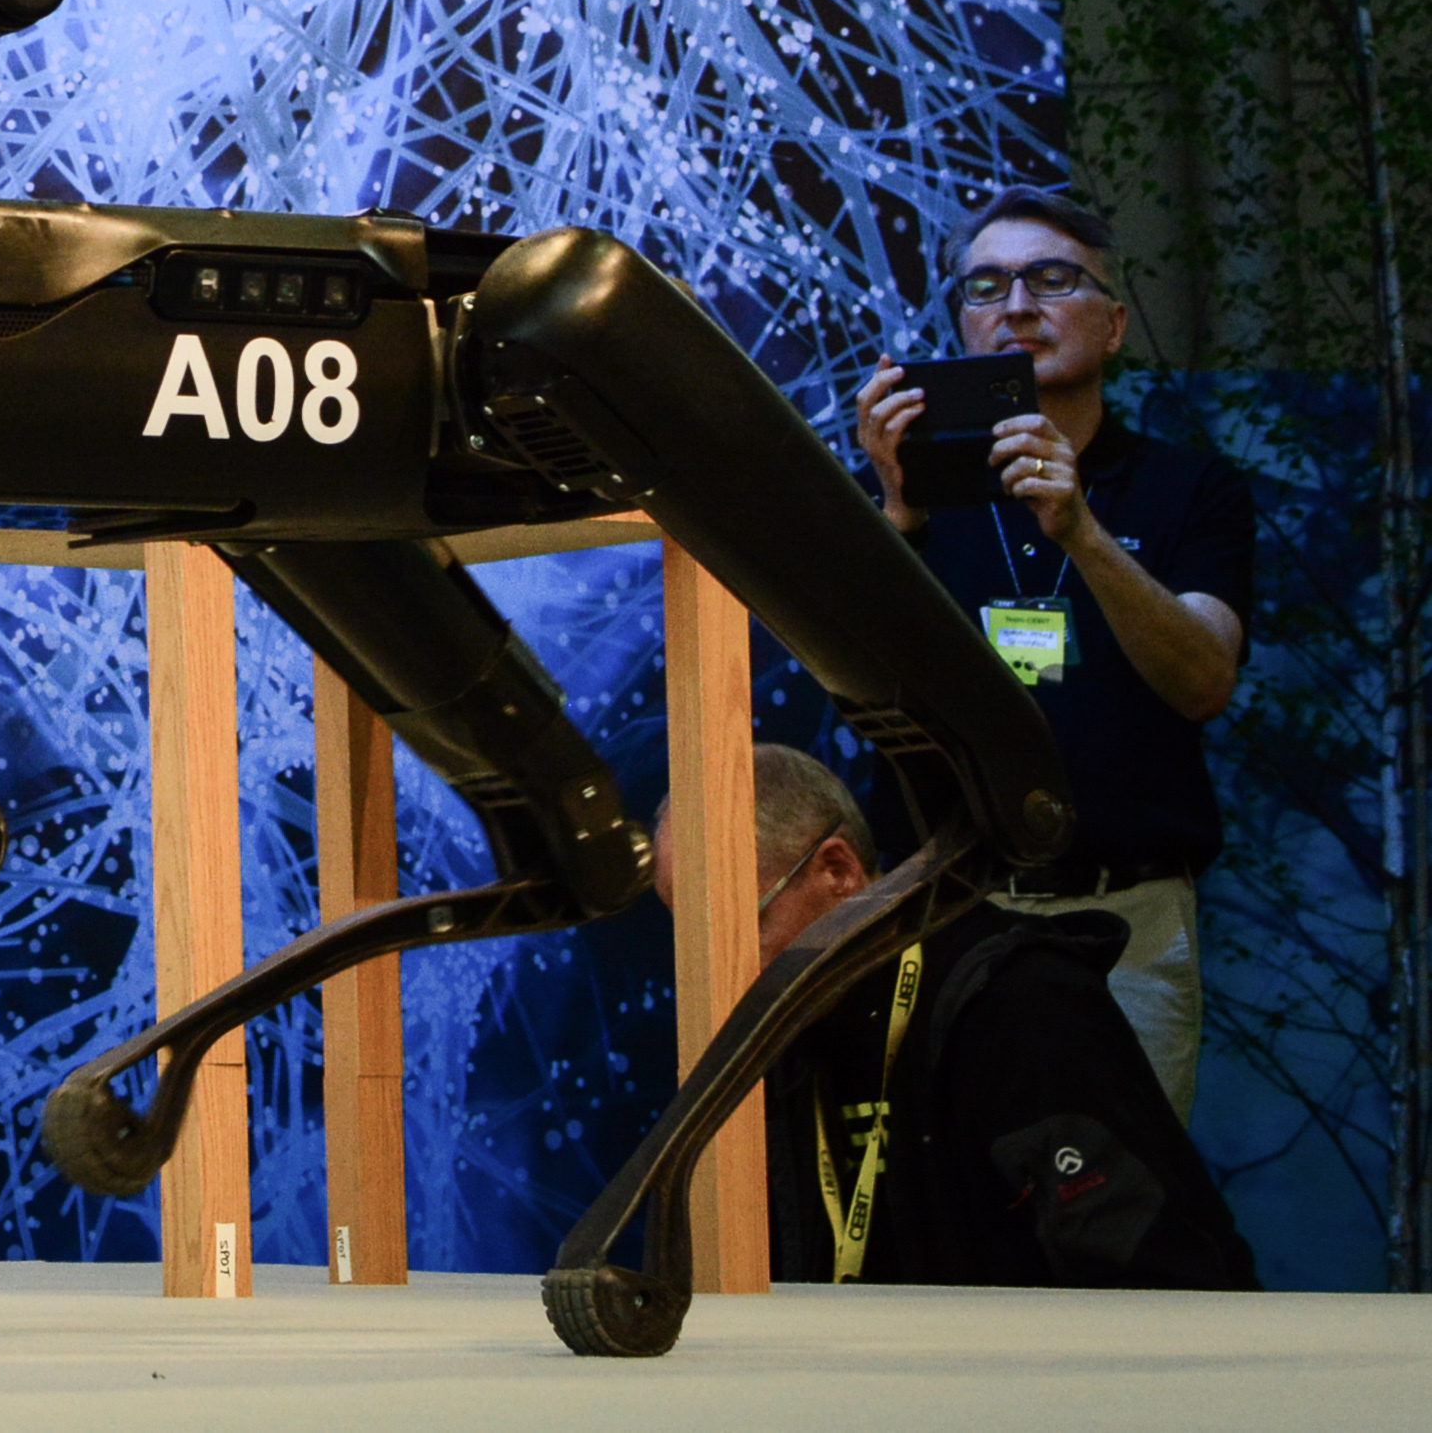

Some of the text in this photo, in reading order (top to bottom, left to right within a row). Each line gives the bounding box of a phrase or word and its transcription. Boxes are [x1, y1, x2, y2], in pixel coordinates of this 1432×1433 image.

[141, 333, 361, 445] A08
[896, 960, 919, 1016] CEBIT
[848, 1188, 870, 1242] CEBIT
[219, 1239, 231, 1277] SPOT
